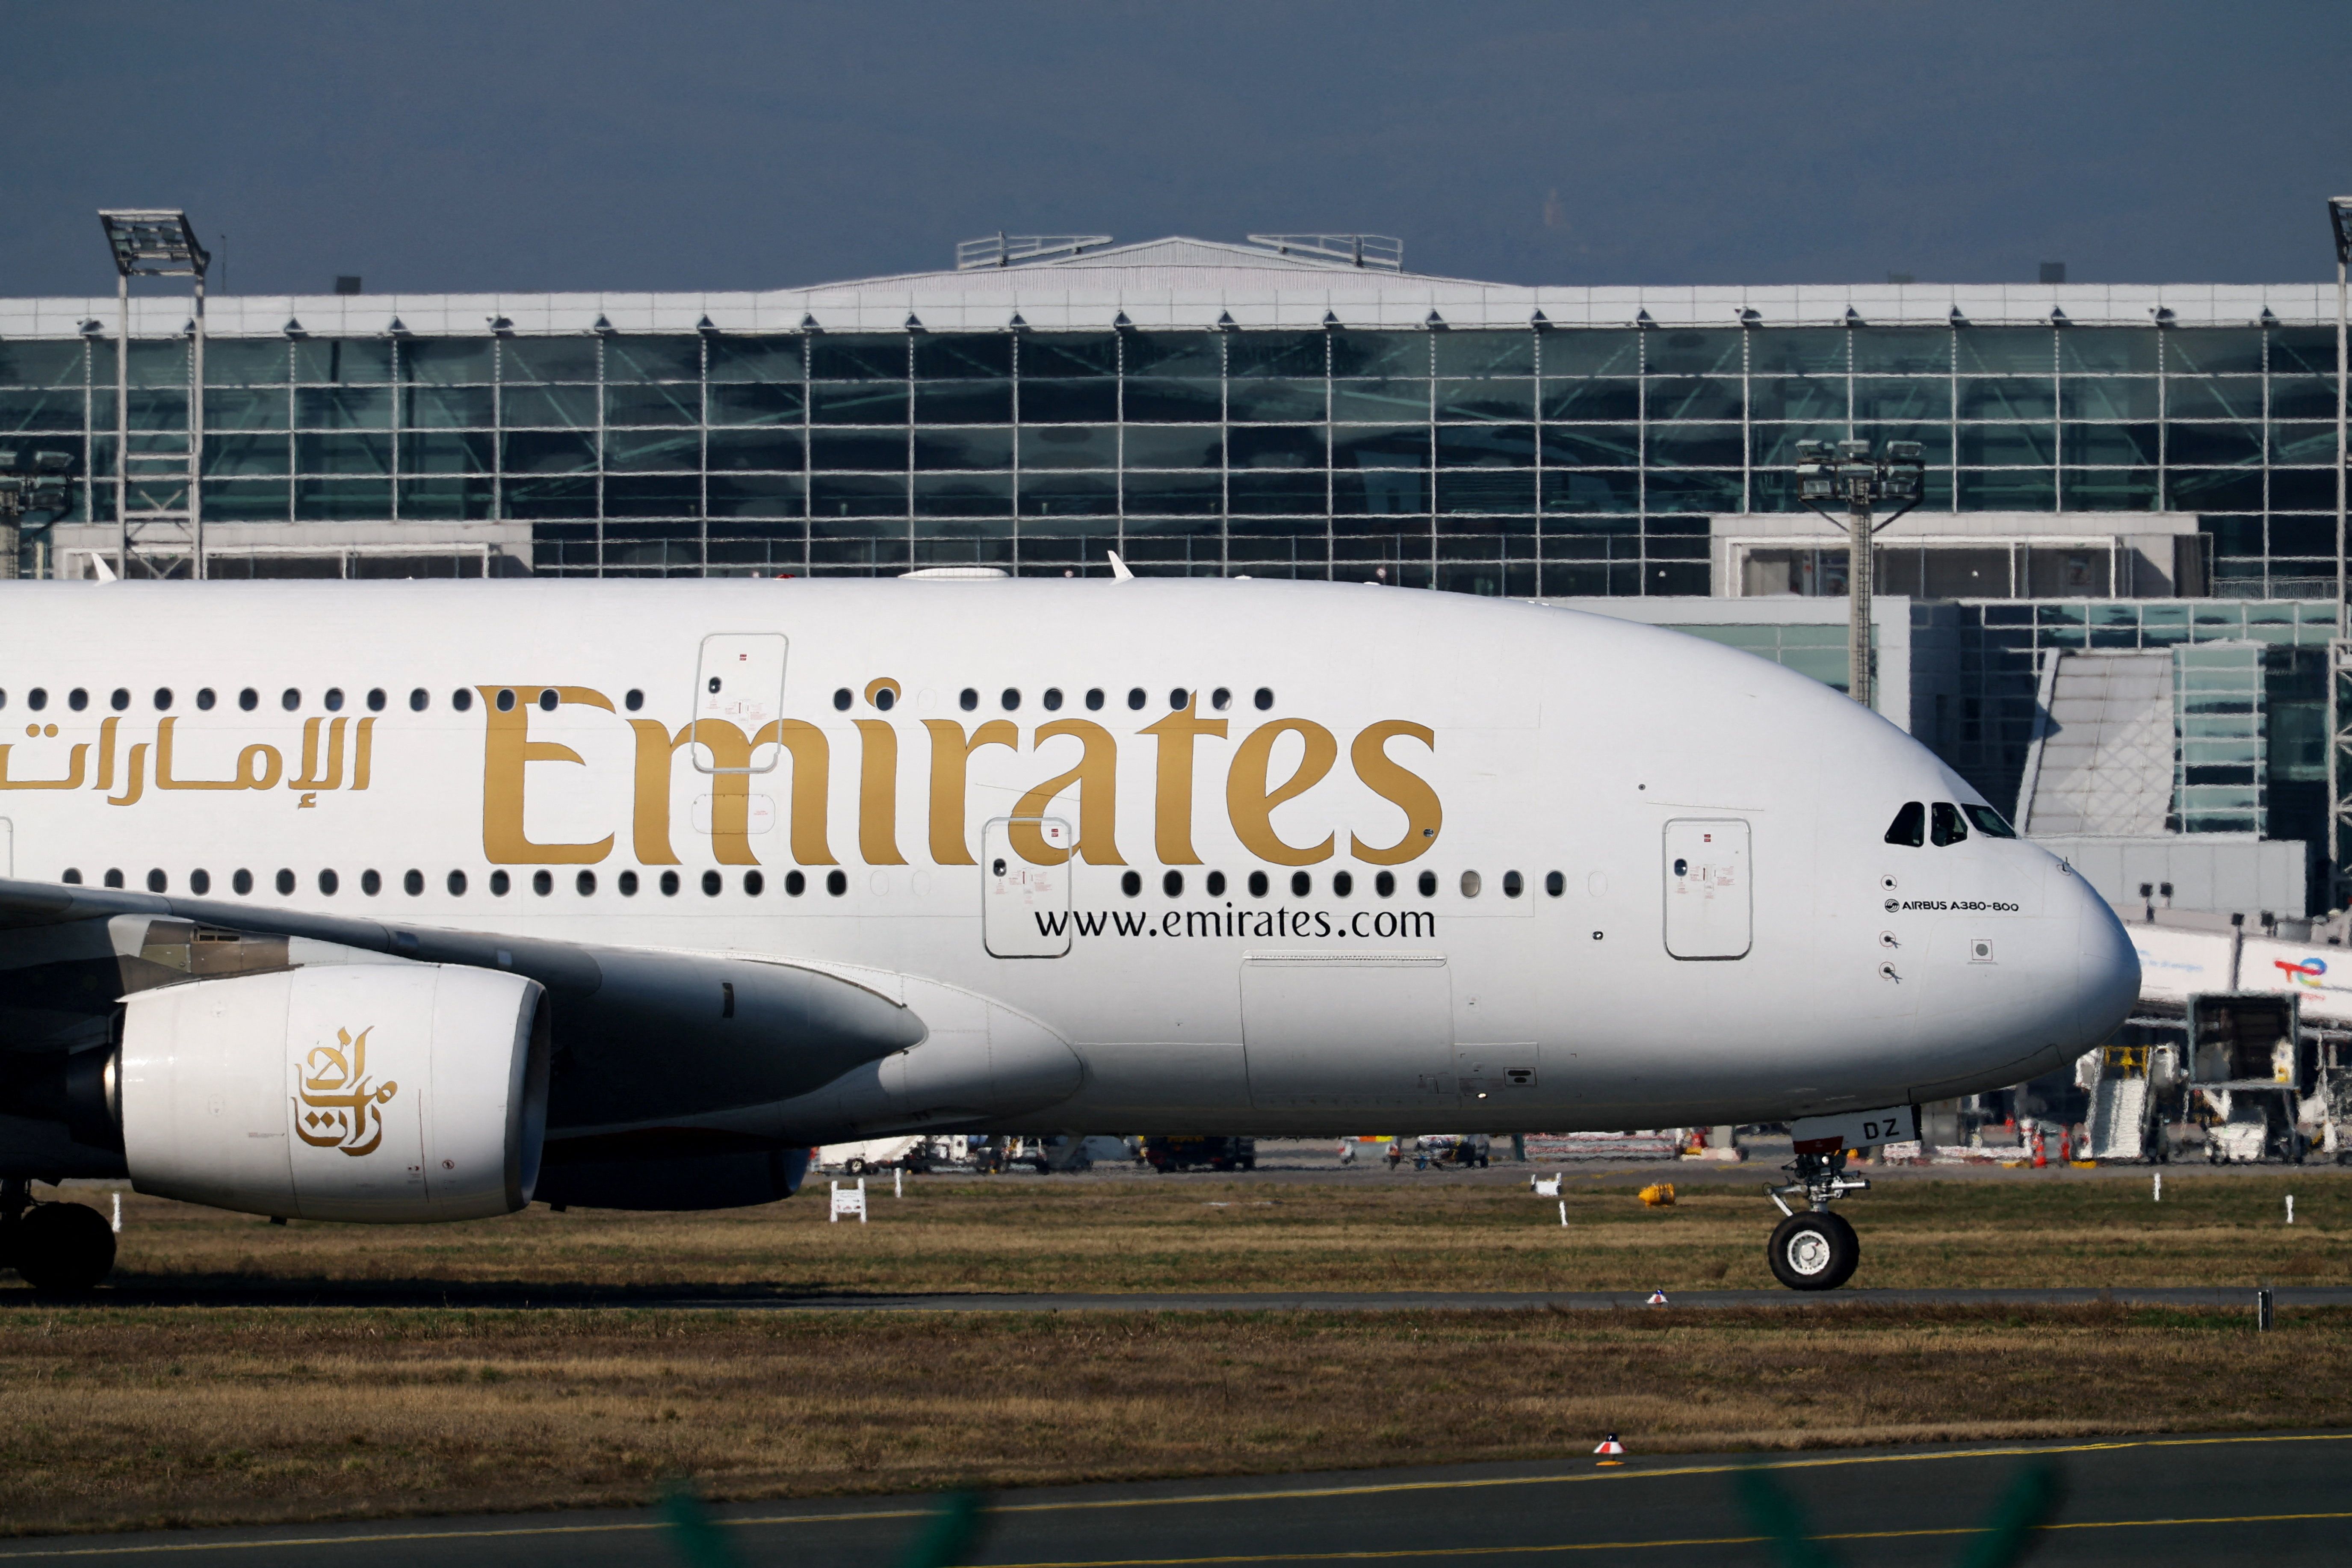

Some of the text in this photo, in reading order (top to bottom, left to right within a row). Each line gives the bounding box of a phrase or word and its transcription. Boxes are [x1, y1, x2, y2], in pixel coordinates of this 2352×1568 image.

[476, 676, 1442, 866] Emirates
[1034, 901, 1435, 937] www.emirates.com
[1902, 901, 2019, 912] AIRBUS A380-800
[1863, 1118, 1900, 1140] DZ
